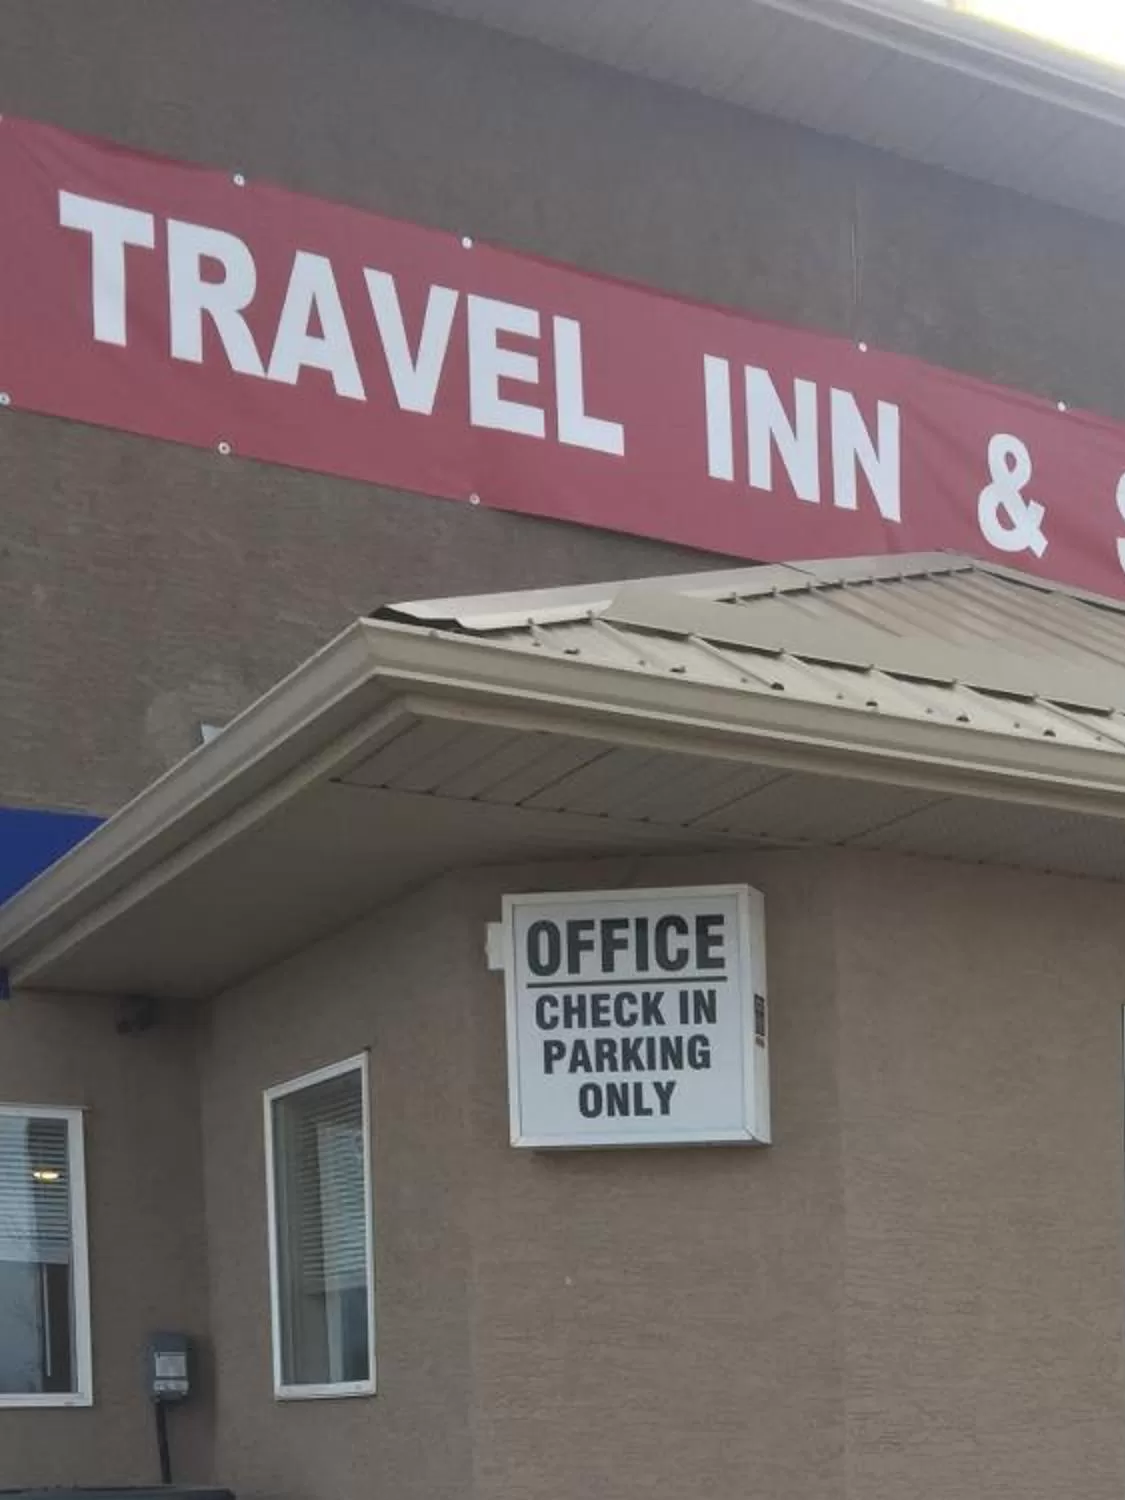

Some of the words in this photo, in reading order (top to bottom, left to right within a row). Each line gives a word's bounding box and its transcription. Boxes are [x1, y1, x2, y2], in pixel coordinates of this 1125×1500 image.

[58, 188, 625, 457] TRAVEL
[703, 353, 902, 523] INN
[977, 432, 1049, 559] &
[526, 914, 726, 977] OFFICE
[535, 991, 666, 1031] CHECK
[679, 989, 717, 1025] IN
[543, 1034, 712, 1075] PARKING
[578, 1080, 677, 1119] ONLY
